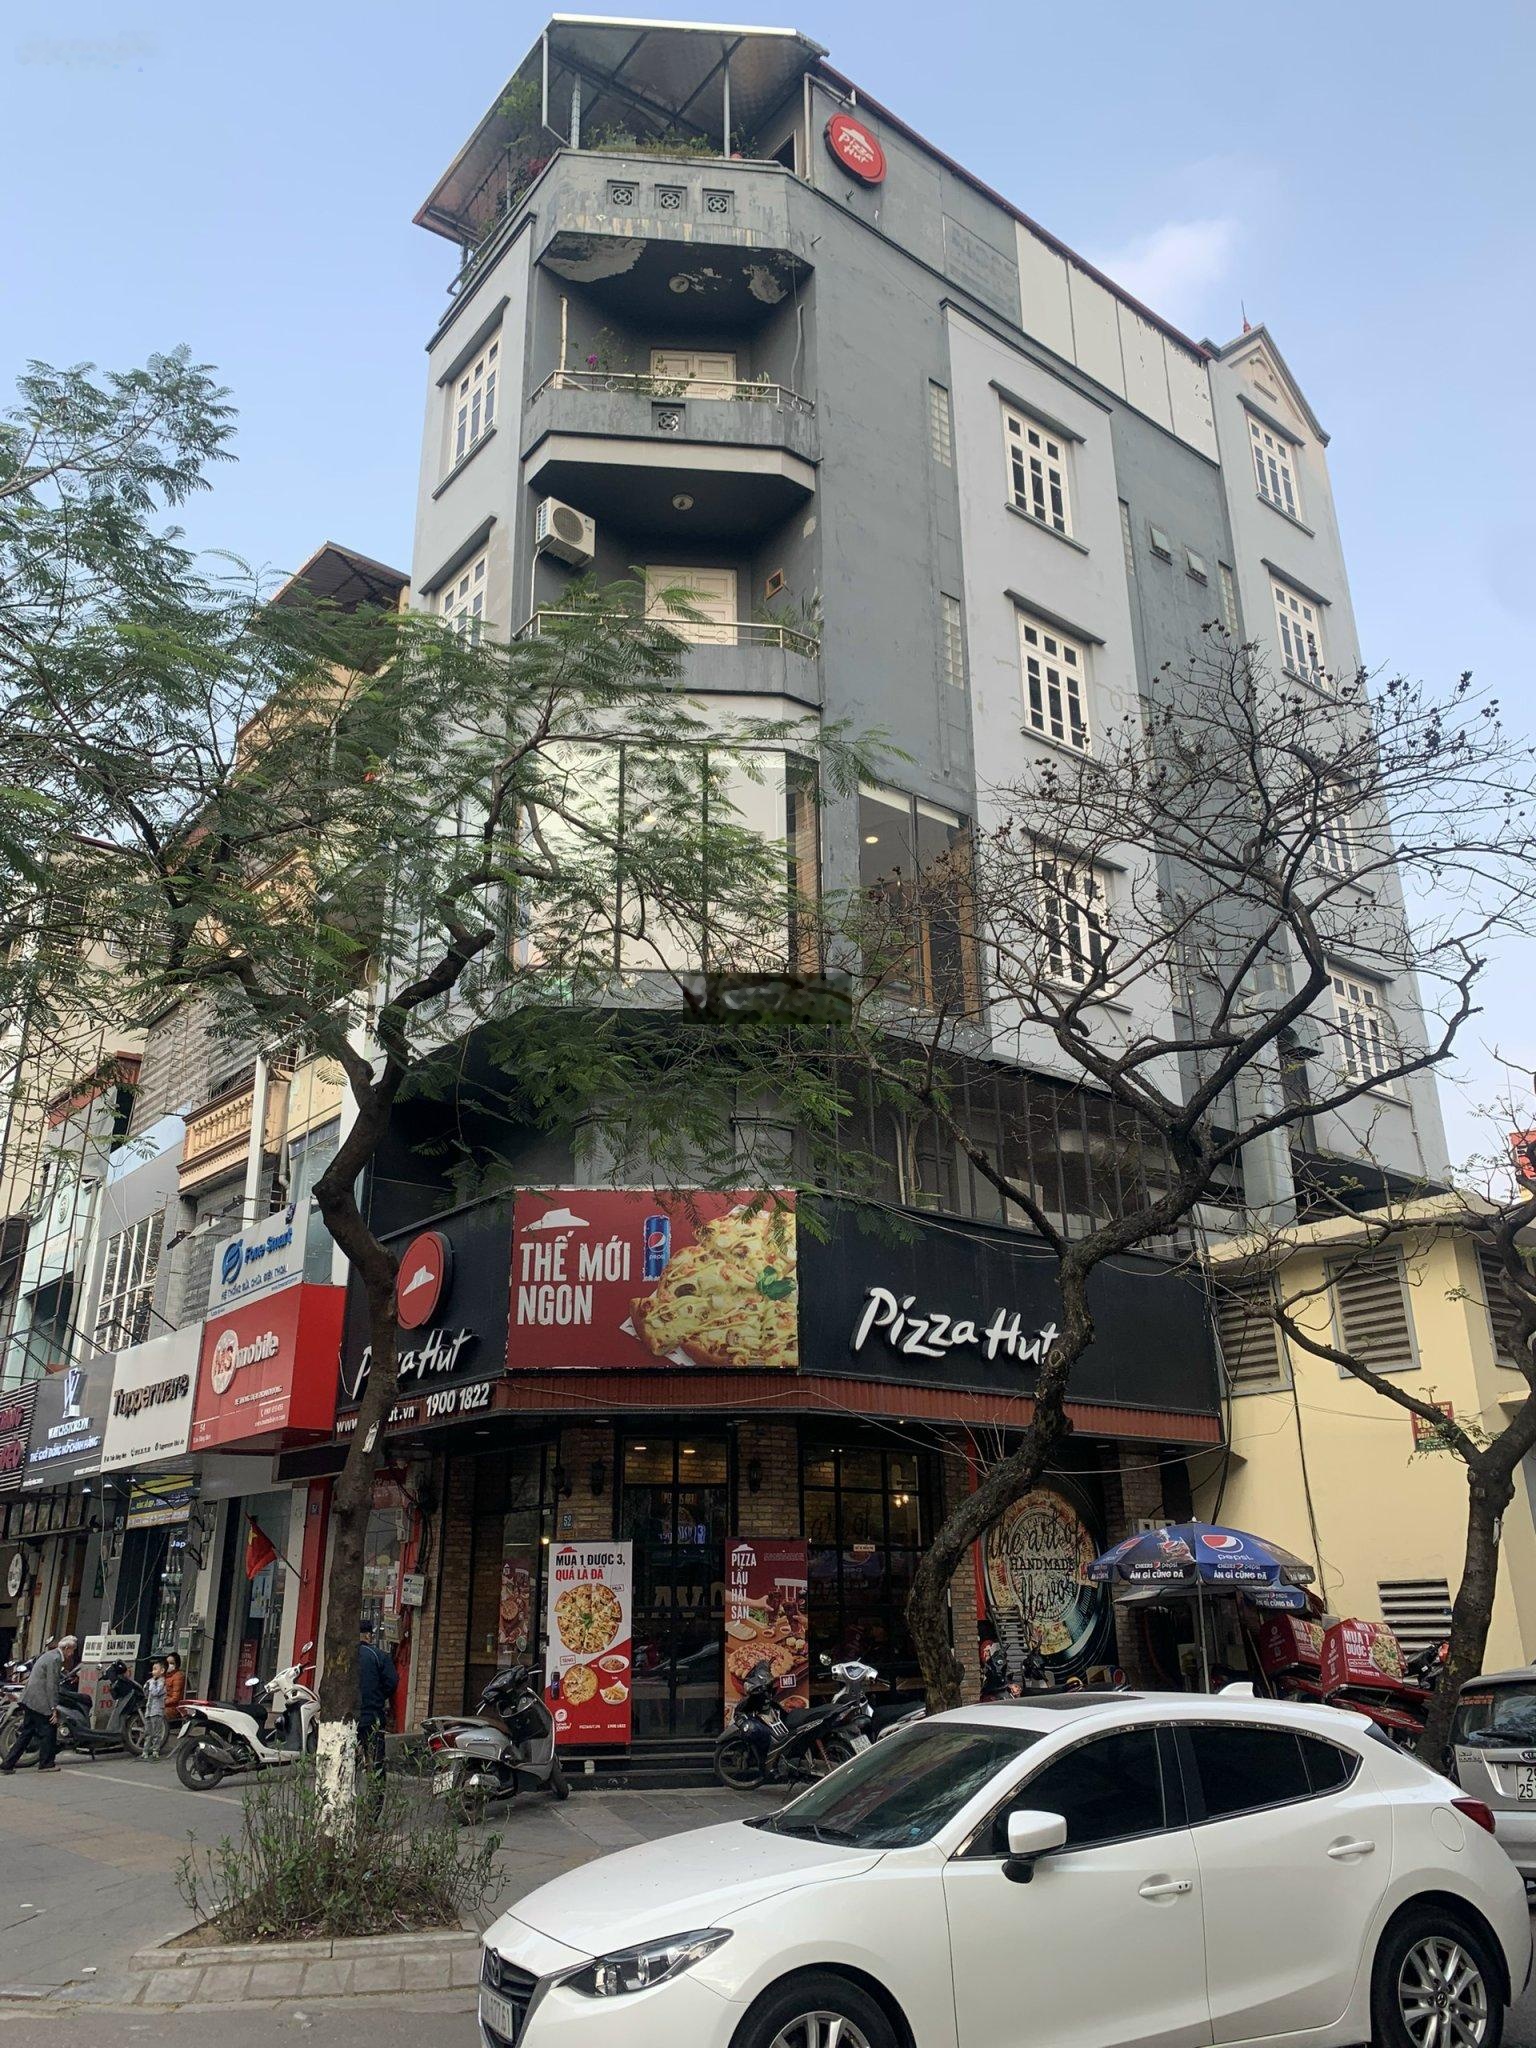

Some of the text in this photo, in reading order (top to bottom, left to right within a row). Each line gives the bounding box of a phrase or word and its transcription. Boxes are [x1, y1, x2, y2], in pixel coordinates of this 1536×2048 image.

[838, 131, 874, 162] Pizza
[520, 1230, 631, 1282] THẾ MỚI
[517, 1284, 593, 1326] NGON
[854, 1286, 1060, 1365] Pizza Hut
[416, 1328, 474, 1380] Hut
[113, 1373, 190, 1419] Tupperware
[426, 1388, 456, 1418] 1900
[459, 1382, 490, 1411] 1822
[555, 1554, 577, 1566] MUA
[579, 1554, 584, 1566] 1
[731, 1553, 757, 1567] PIZZA
[1009, 1557, 1076, 1571] HANDMADE
[1343, 1630, 1364, 1646] MUA
